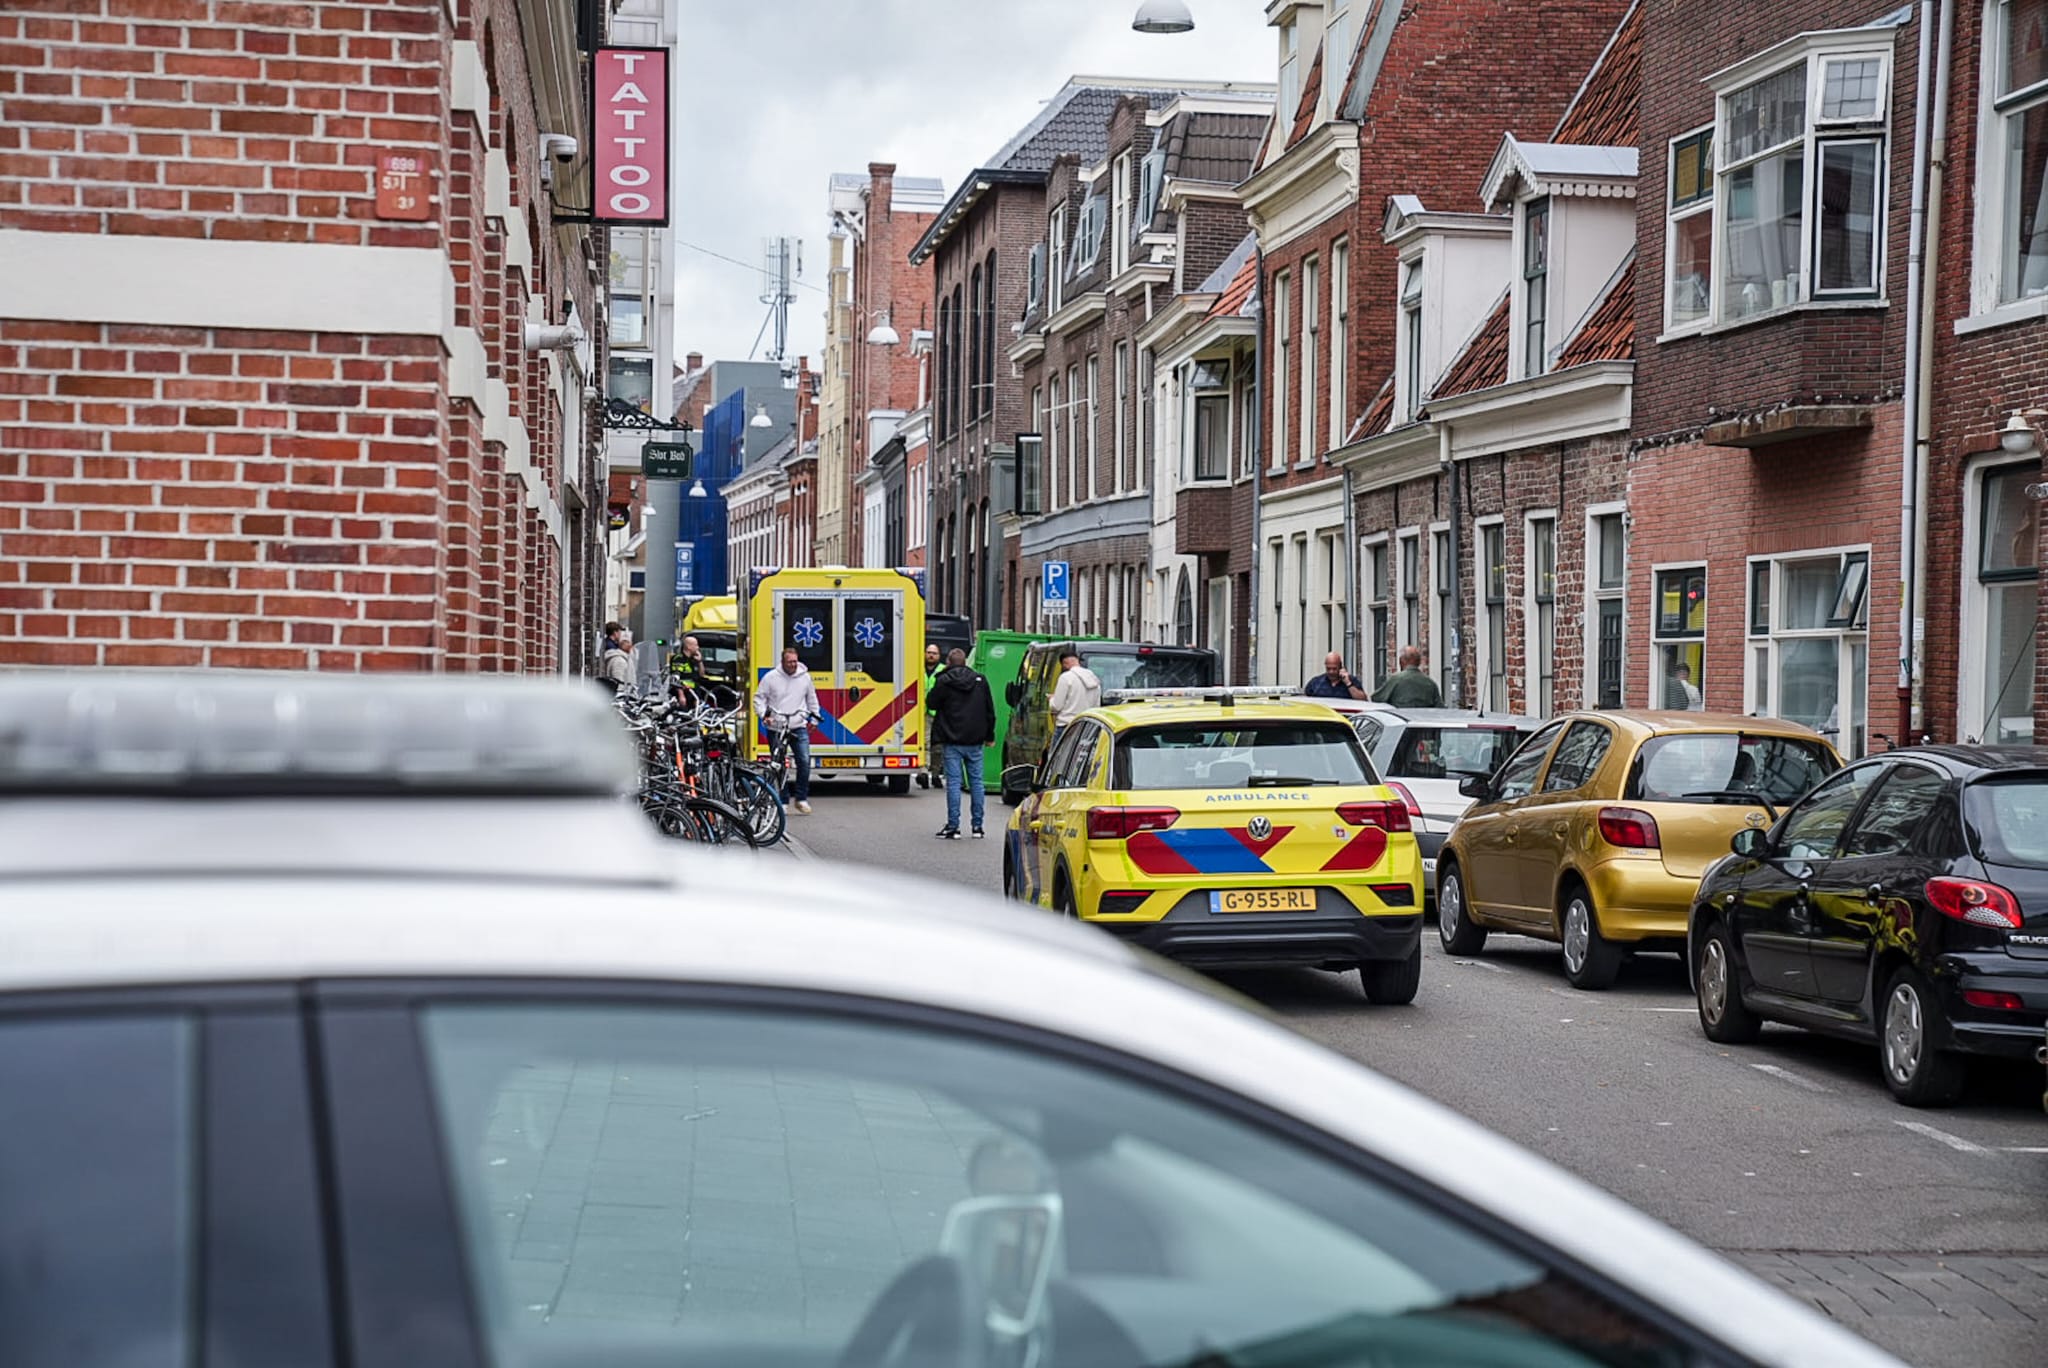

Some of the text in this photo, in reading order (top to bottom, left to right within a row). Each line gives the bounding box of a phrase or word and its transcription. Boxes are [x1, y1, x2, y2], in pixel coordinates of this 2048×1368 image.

[609, 53, 651, 214] TATTOO
[1048, 564, 1063, 585] P
[1205, 793, 1310, 802] AMBULANCE
[1225, 890, 1311, 909] G-955-RL
